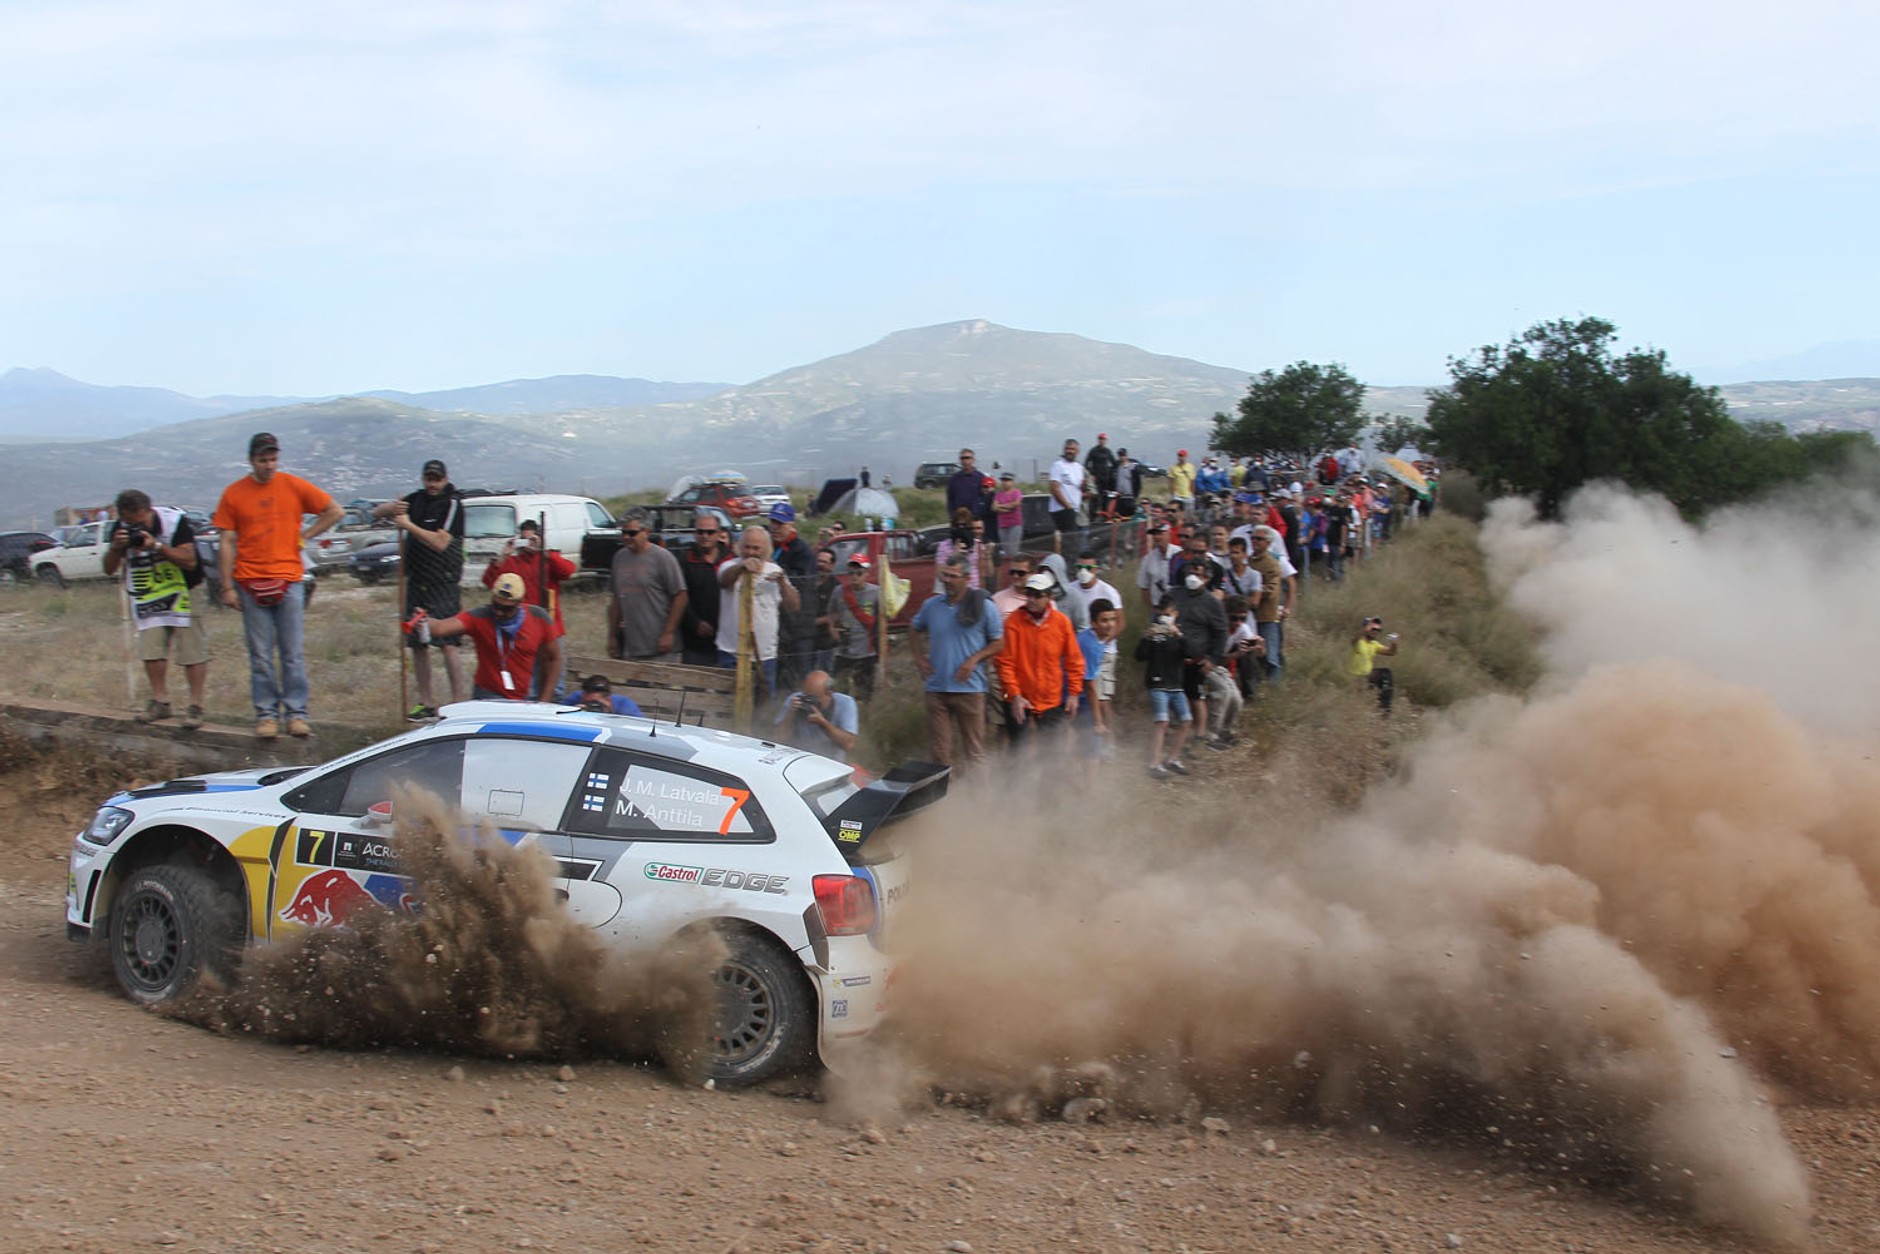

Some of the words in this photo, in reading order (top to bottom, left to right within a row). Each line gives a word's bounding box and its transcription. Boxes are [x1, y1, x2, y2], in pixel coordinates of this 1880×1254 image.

[620, 778, 632, 793] J.
[636, 780, 655, 797] M.
[660, 783, 720, 806] Latvala
[616, 800, 638, 818] M.
[643, 804, 703, 827] Anttila
[718, 786, 750, 835] 7
[309, 830, 326, 864] 7
[838, 830, 860, 841] OMP
[658, 865, 699, 882] Castrol
[701, 867, 790, 895] EDGE
